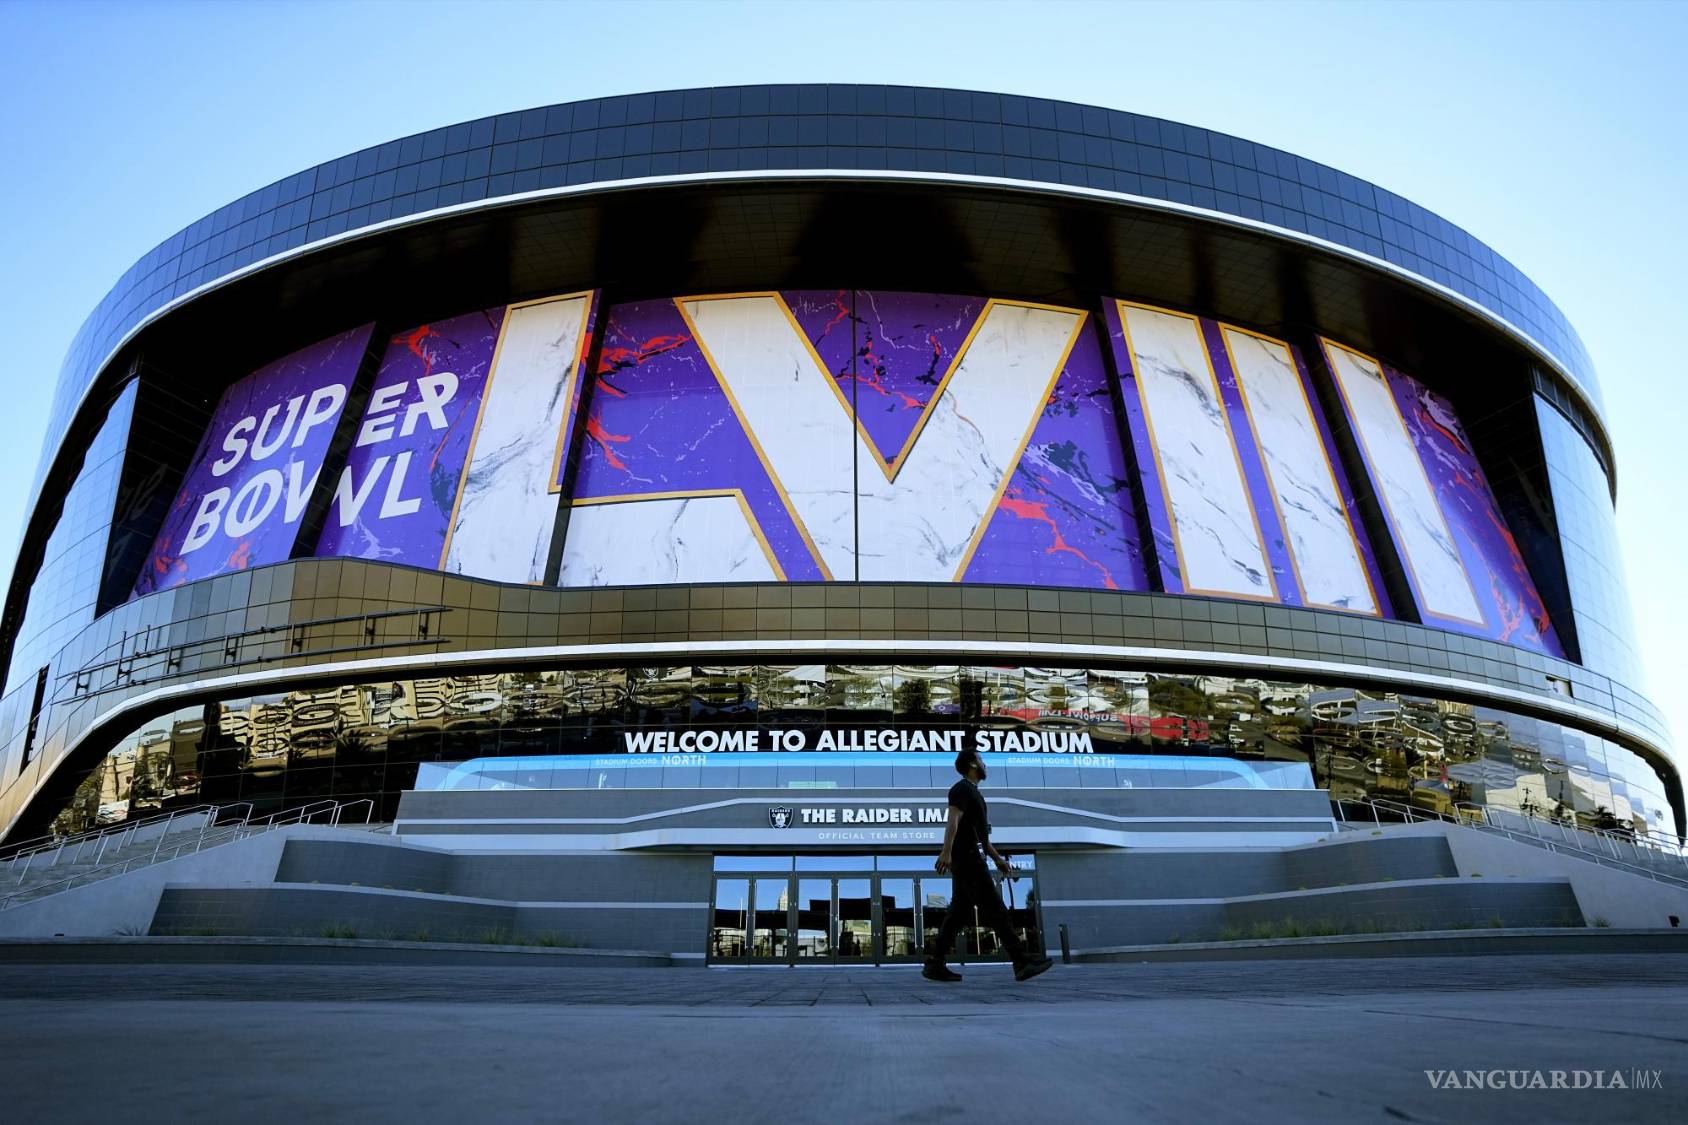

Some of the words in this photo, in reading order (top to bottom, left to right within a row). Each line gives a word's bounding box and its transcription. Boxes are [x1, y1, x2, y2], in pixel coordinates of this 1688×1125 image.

[212, 371, 460, 477] SUPER
[179, 451, 423, 556] BOWL
[624, 730, 758, 753] WELCOME
[768, 729, 806, 752] TO
[815, 729, 966, 752] ALLEGIANT
[975, 730, 1094, 753] STADIUM
[596, 758, 628, 766] STADIUM
[630, 757, 657, 765] DOORS
[661, 755, 707, 765] NORTH
[1073, 756, 1115, 767] NORTH
[801, 808, 836, 823] THE
[842, 808, 913, 823] RAIDER
[918, 808, 949, 823] IMA
[818, 832, 865, 840] OFFICIAL
[902, 832, 935, 840] STORE
[1009, 860, 1033, 869] NTRY
